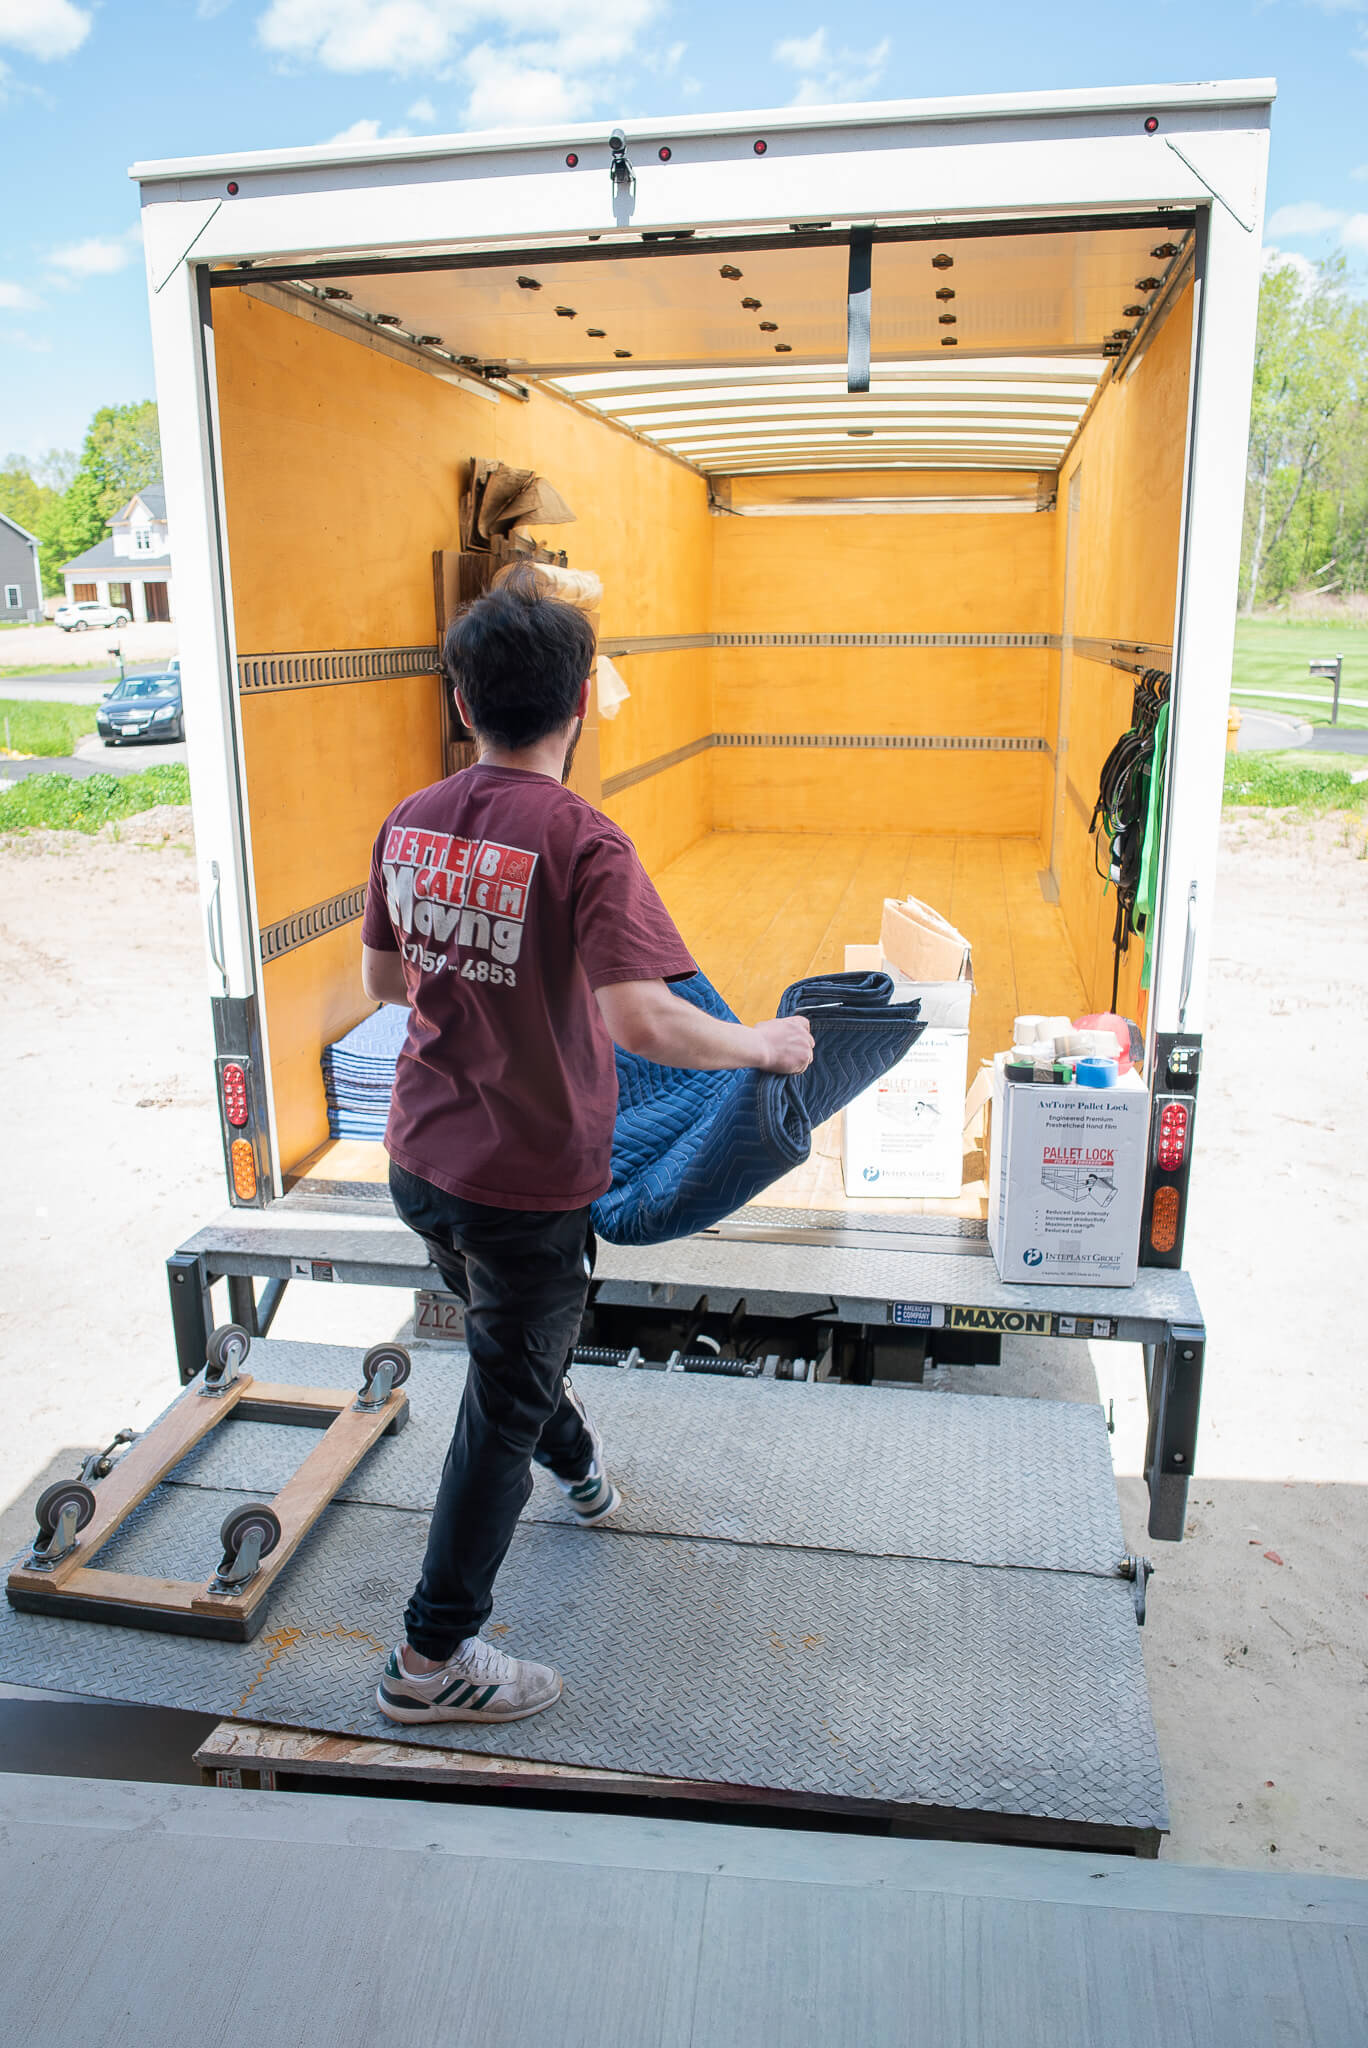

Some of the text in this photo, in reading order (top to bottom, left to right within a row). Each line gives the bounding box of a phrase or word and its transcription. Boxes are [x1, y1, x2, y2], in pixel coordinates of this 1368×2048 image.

[383, 864, 524, 965] Movng
[460, 959, 517, 988] 4853
[1078, 1102, 1103, 1110] Pallet
[1106, 1103, 1129, 1111] Lock
[1043, 1146, 1114, 1161] PALLET LOCK
[903, 1311, 930, 1320] COMPANY
[953, 1308, 1045, 1332] MAXON
